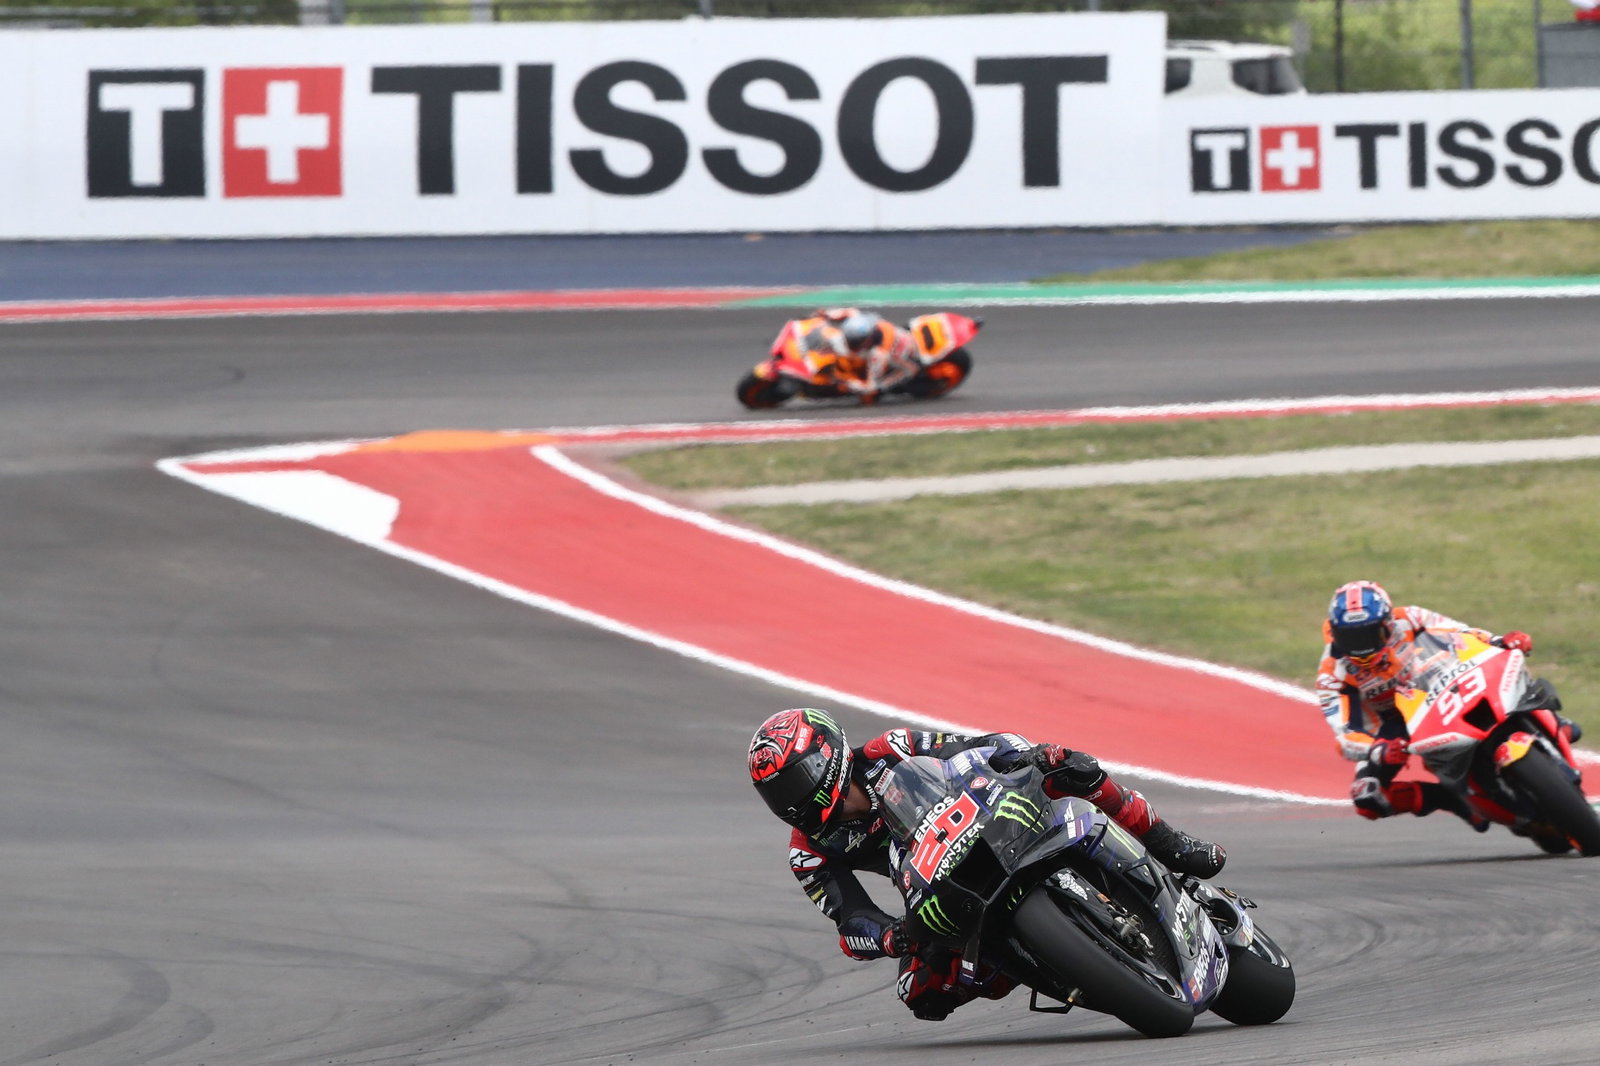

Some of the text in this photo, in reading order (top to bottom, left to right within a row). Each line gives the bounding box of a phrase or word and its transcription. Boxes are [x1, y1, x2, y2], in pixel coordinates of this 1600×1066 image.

[370, 55, 1109, 196] TISSOT
[1437, 665, 1488, 727] 93
[910, 791, 980, 885] 20
[914, 795, 956, 844] ENEOS
[844, 935, 881, 952] YAMAHA
